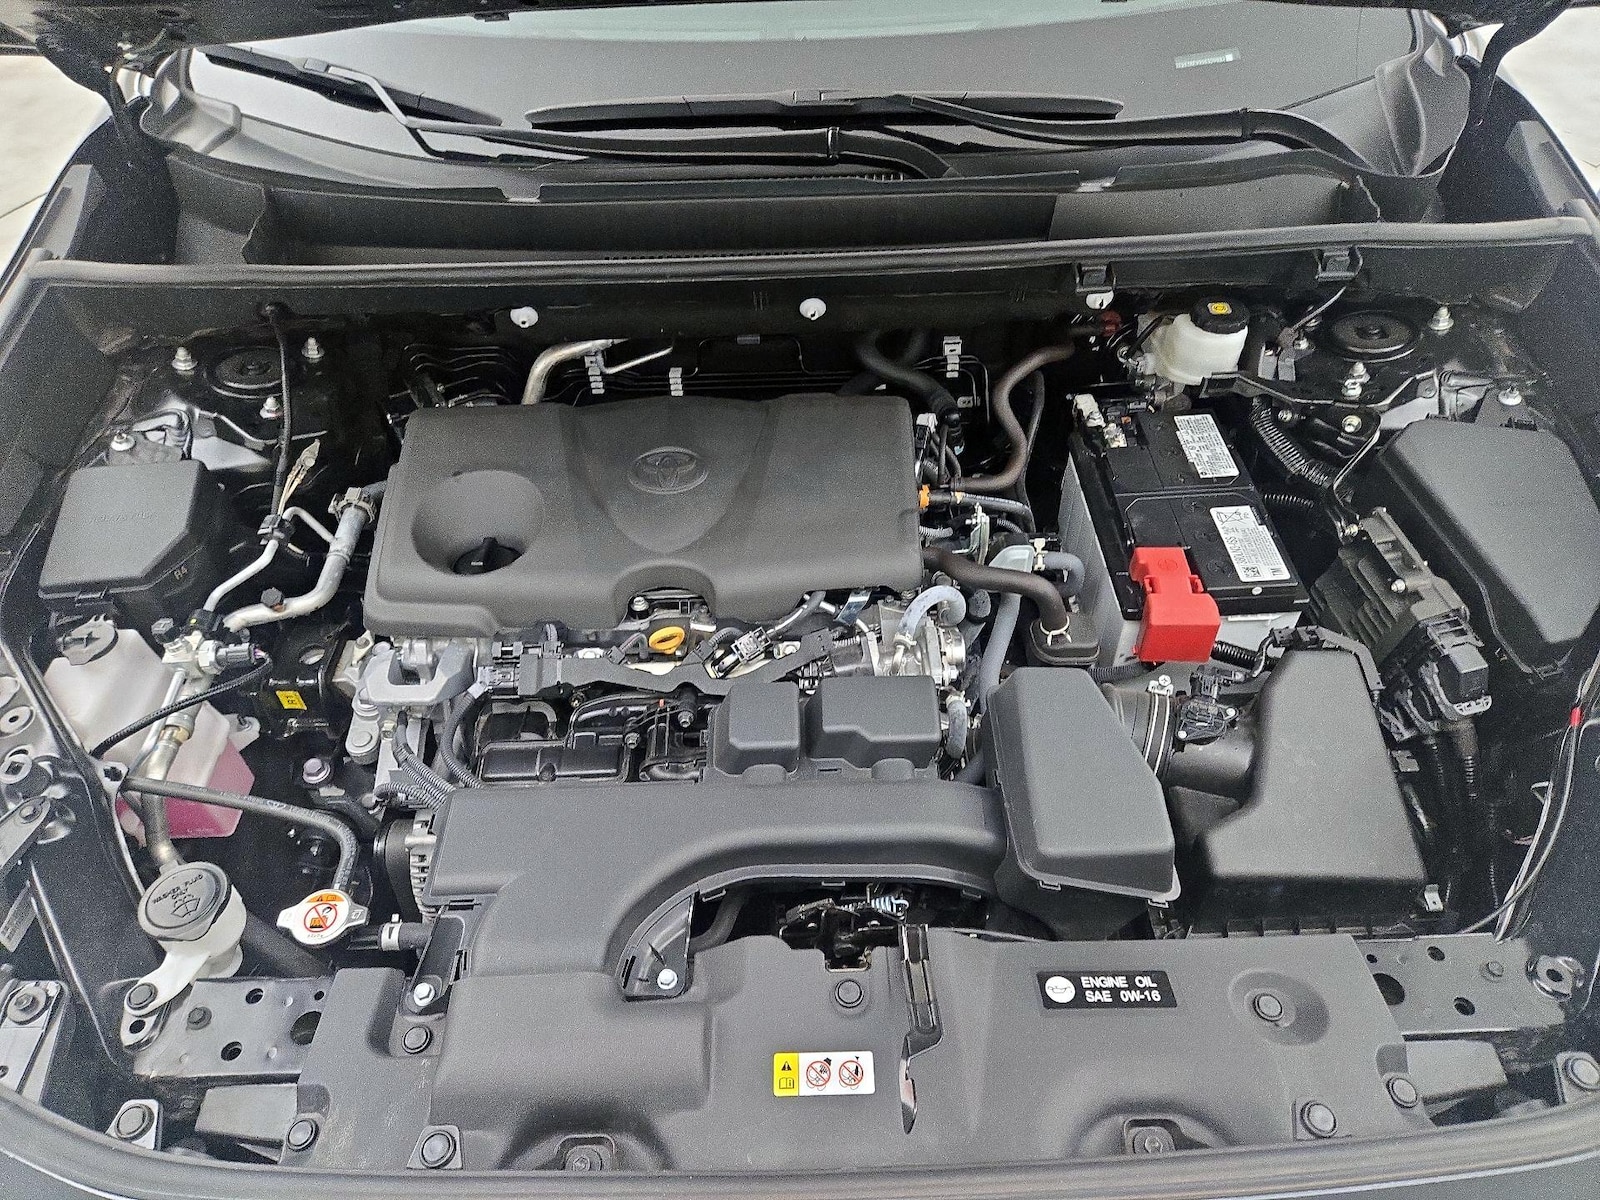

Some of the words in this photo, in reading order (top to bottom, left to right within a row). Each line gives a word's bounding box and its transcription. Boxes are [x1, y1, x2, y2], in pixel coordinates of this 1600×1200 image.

[152, 886, 181, 904] WASHER
[185, 874, 204, 887] FLUID
[171, 887, 189, 900] ONLY
[1080, 976, 1128, 988] ENGINE
[1134, 976, 1157, 988] OIL
[1085, 990, 1113, 1002] SAE
[1120, 990, 1161, 1002] 0W-16
